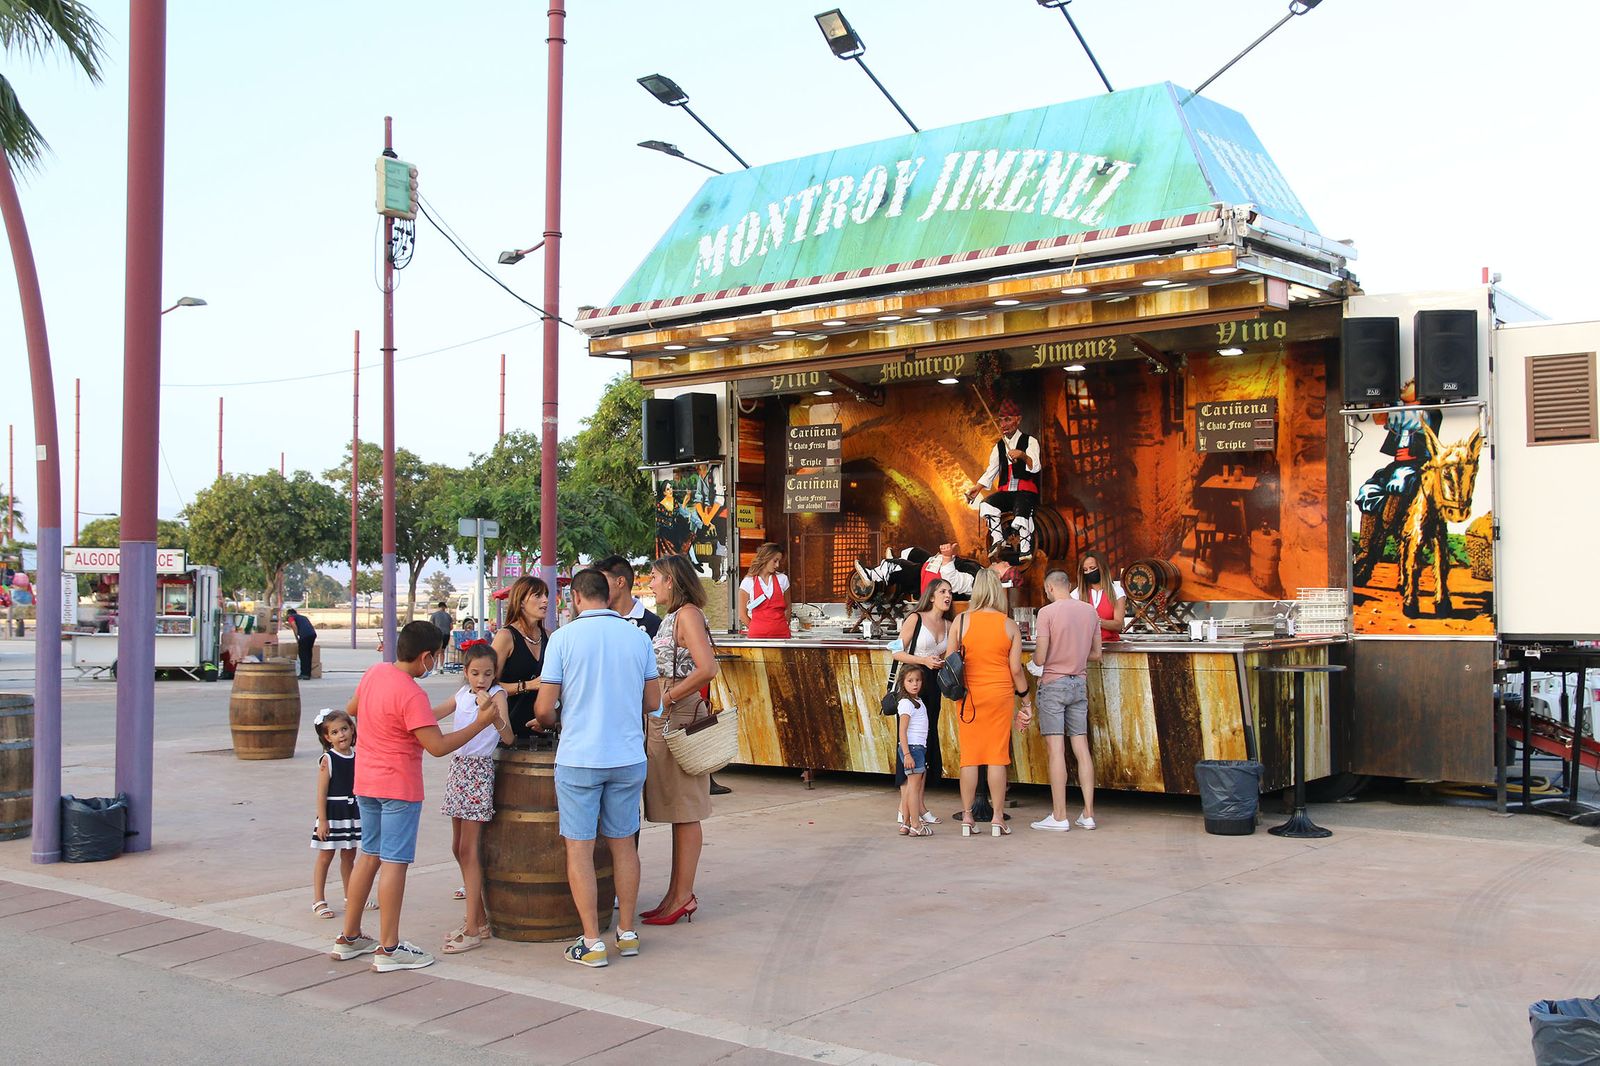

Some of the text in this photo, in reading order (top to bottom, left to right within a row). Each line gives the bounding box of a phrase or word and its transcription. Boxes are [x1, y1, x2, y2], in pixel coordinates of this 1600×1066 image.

[692, 149, 1136, 288] MONTROY JIMENEZ
[879, 354, 965, 383] Montroy
[1031, 338, 1117, 368] Jimenez
[1216, 319, 1287, 345] Vino
[1201, 402, 1268, 416] Cariñena
[1206, 421, 1227, 431] Chato
[1227, 420, 1251, 431] Fresco
[790, 426, 837, 438] Cariñena
[1216, 440, 1246, 450] Triple
[800, 458, 822, 466] Triple
[786, 477, 839, 490] Cariñena
